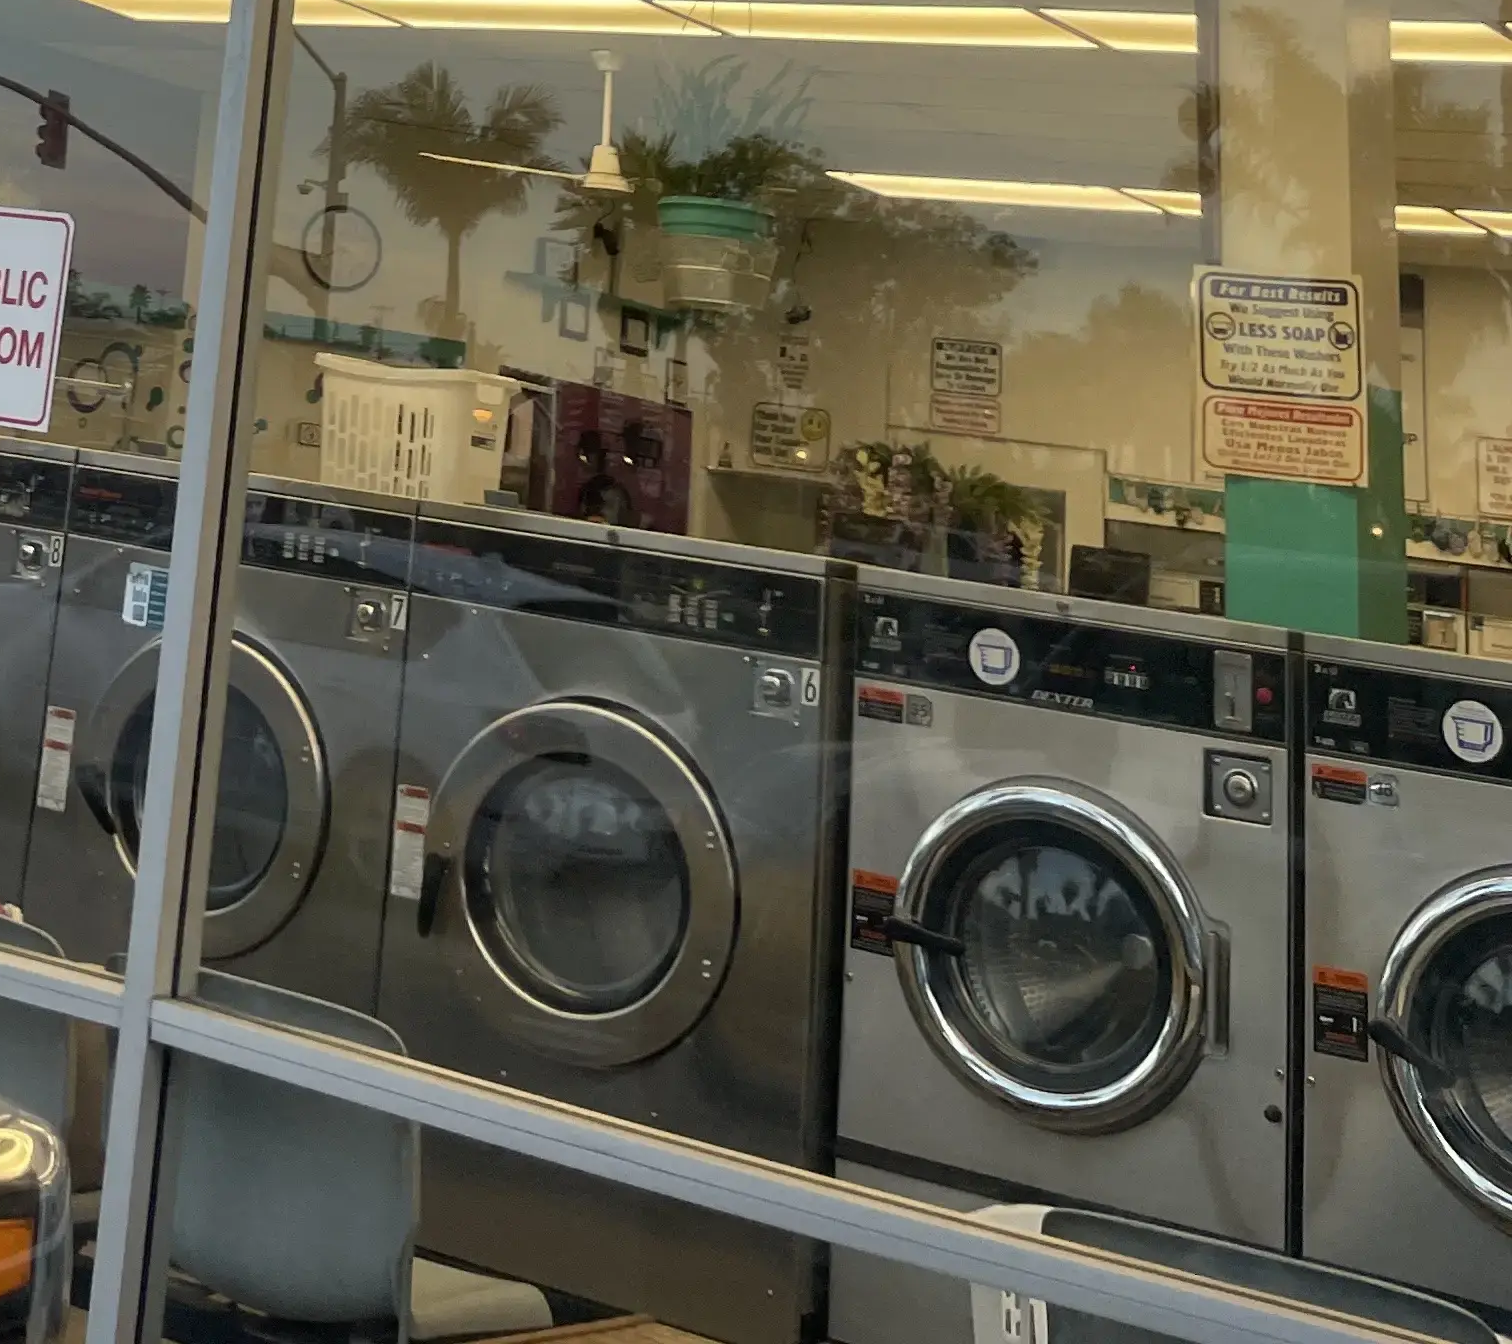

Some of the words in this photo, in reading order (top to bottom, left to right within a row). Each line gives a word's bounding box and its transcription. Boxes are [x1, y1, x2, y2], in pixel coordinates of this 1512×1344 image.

[1218, 282, 1247, 297] For
[1249, 284, 1284, 300] Best
[1288, 286, 1341, 304] Results
[1238, 321, 1279, 340] LESS
[1281, 325, 1326, 343] SOAP
[51, 538, 61, 564] 8
[393, 598, 405, 629] 7
[803, 672, 817, 703] 6
[1031, 689, 1095, 709] DEXTER
